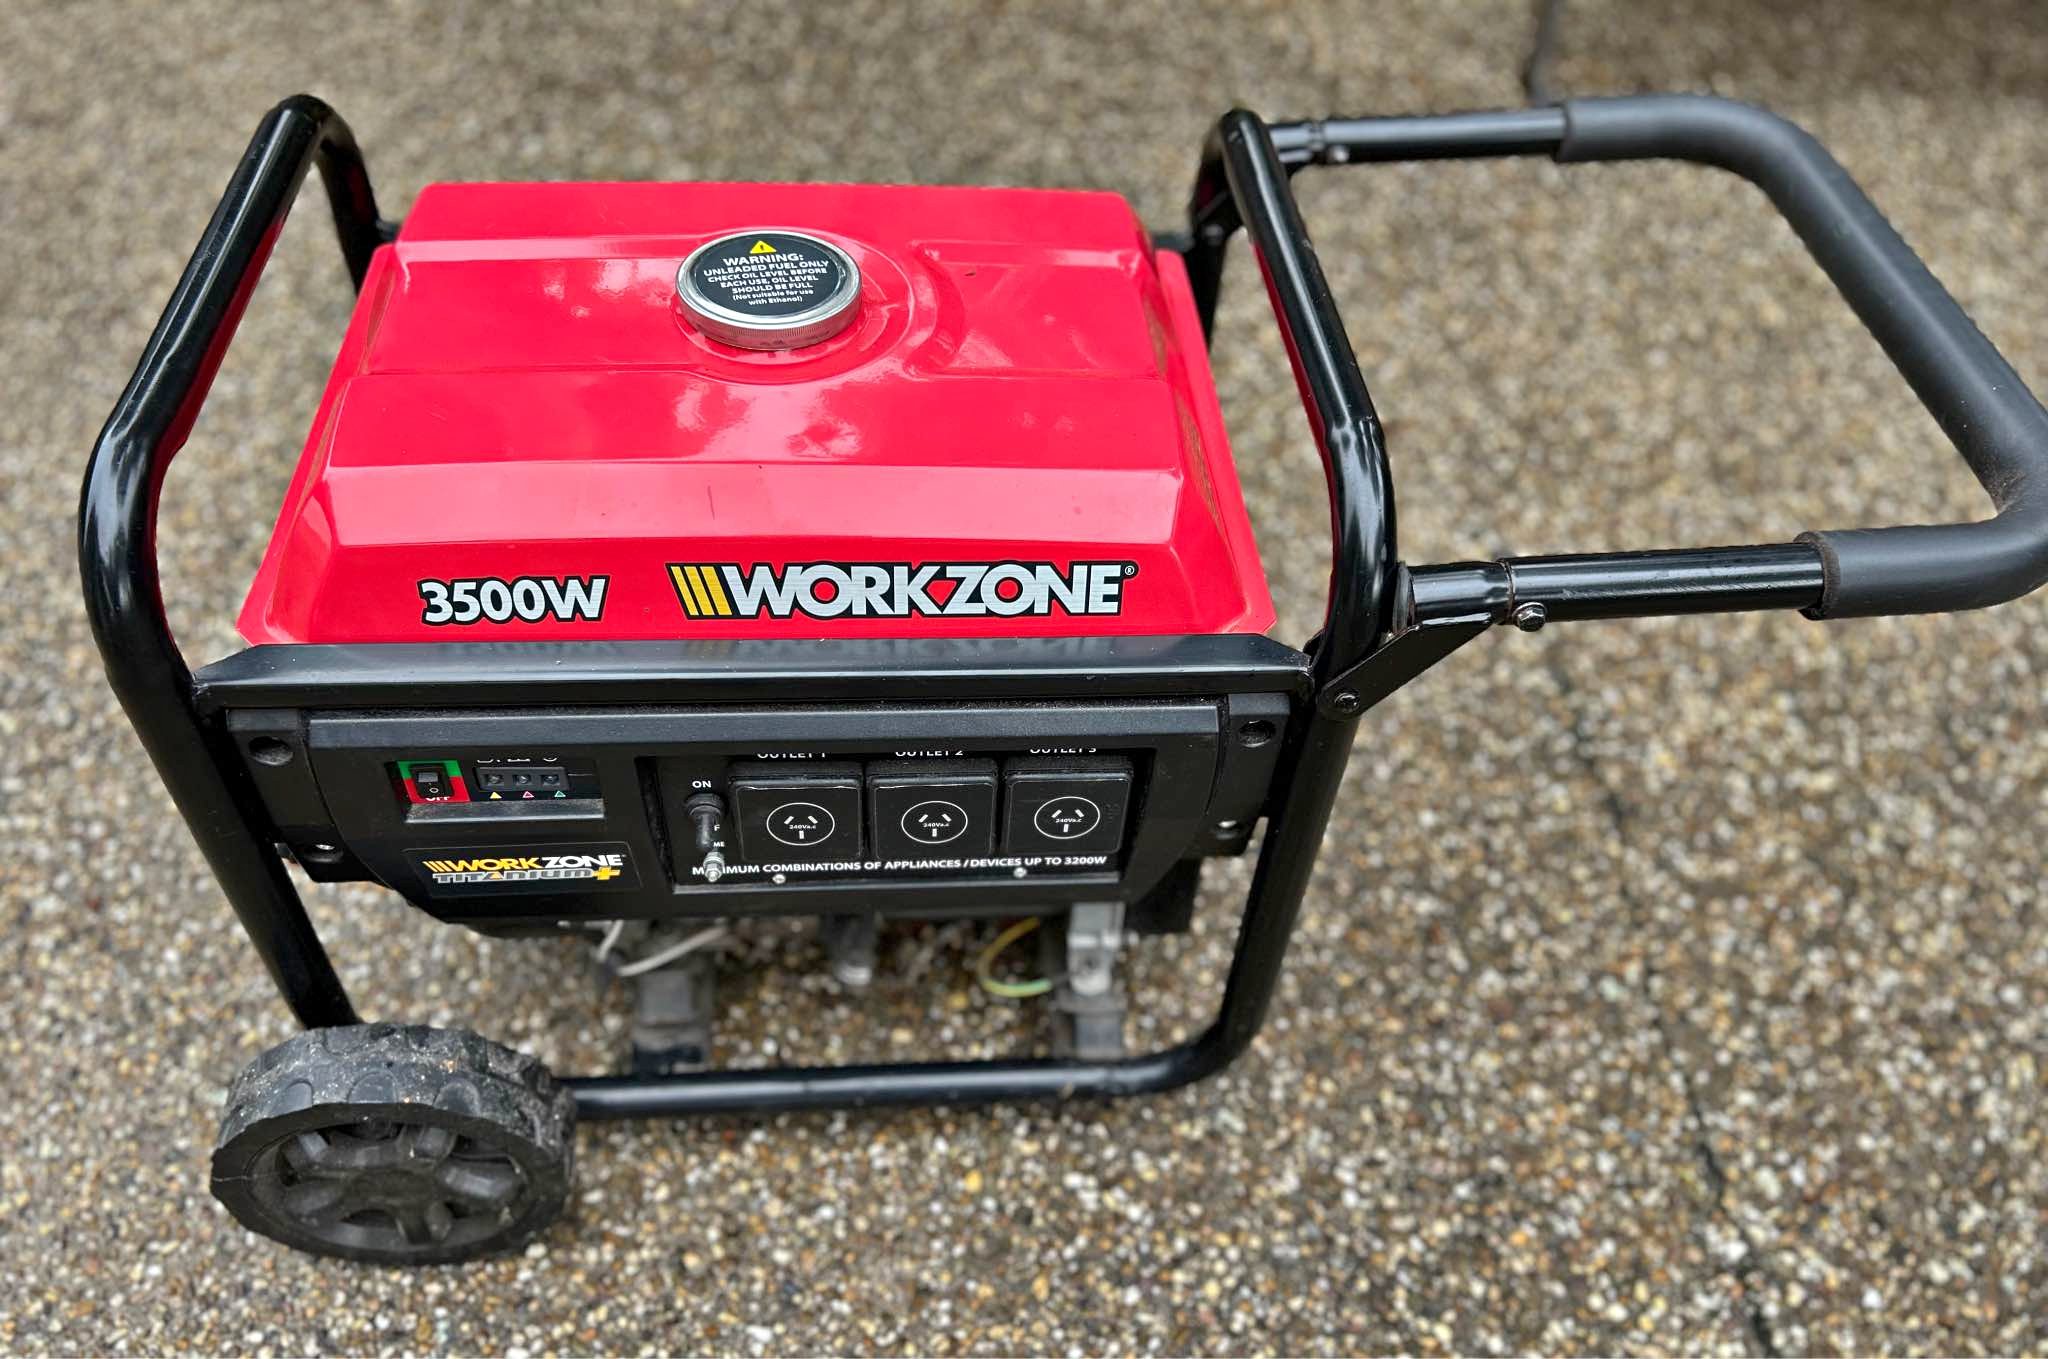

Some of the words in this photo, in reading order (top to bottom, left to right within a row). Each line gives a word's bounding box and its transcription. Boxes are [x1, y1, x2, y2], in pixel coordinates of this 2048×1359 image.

[723, 253, 804, 266] WARNING:
[703, 265, 767, 277] UNLEADED
[769, 262, 798, 270] FUEL
[799, 260, 829, 268] ONLY
[708, 275, 741, 283] CHECK
[760, 270, 789, 278] LEVEL
[790, 267, 827, 276] BEFORE
[720, 280, 747, 288] EACH
[732, 285, 773, 294] SHOULD
[752, 291, 785, 299] suitable
[768, 296, 803, 304] Ethanol)
[419, 577, 608, 624] 3500W
[692, 780, 712, 788] ON
[692, 864, 760, 875] MIMUM
[762, 861, 862, 873] COMBINATIONS
[863, 861, 881, 870] OF
[884, 859, 961, 870] APPLIANCES
[1024, 856, 1042, 866] UP
[1044, 856, 1062, 866] TO
[1064, 855, 1108, 866] 3200W
